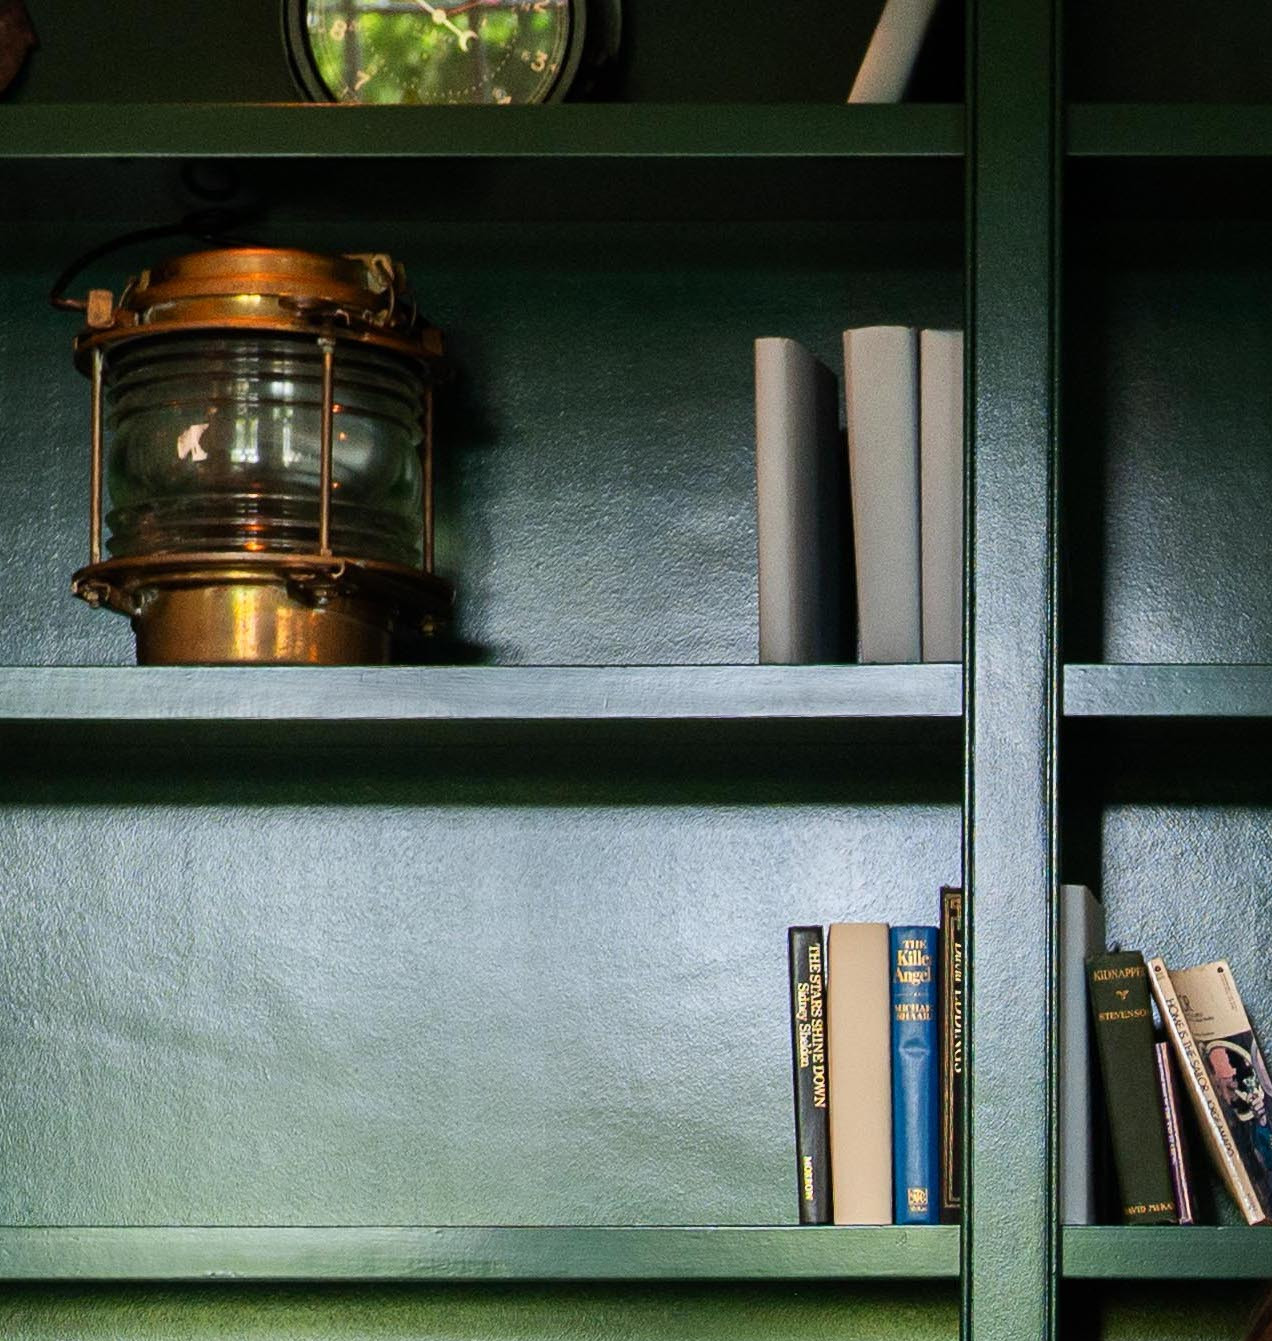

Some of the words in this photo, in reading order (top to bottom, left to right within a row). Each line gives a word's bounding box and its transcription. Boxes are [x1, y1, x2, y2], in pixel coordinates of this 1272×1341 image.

[330, 19, 347, 41] 8
[901, 939, 927, 950] THE
[808, 943, 821, 973] THE
[897, 950, 931, 967] Kille
[894, 966, 932, 985] Angel
[1094, 966, 1146, 982] KIDNAPPE
[796, 982, 810, 1022] Sidney
[810, 974, 823, 1018] STARS
[1098, 1008, 1148, 1021] STEVENSO
[1165, 998, 1185, 1031] HOME
[811, 1018, 824, 1063] SHINE
[813, 1063, 826, 1108] DOWN
